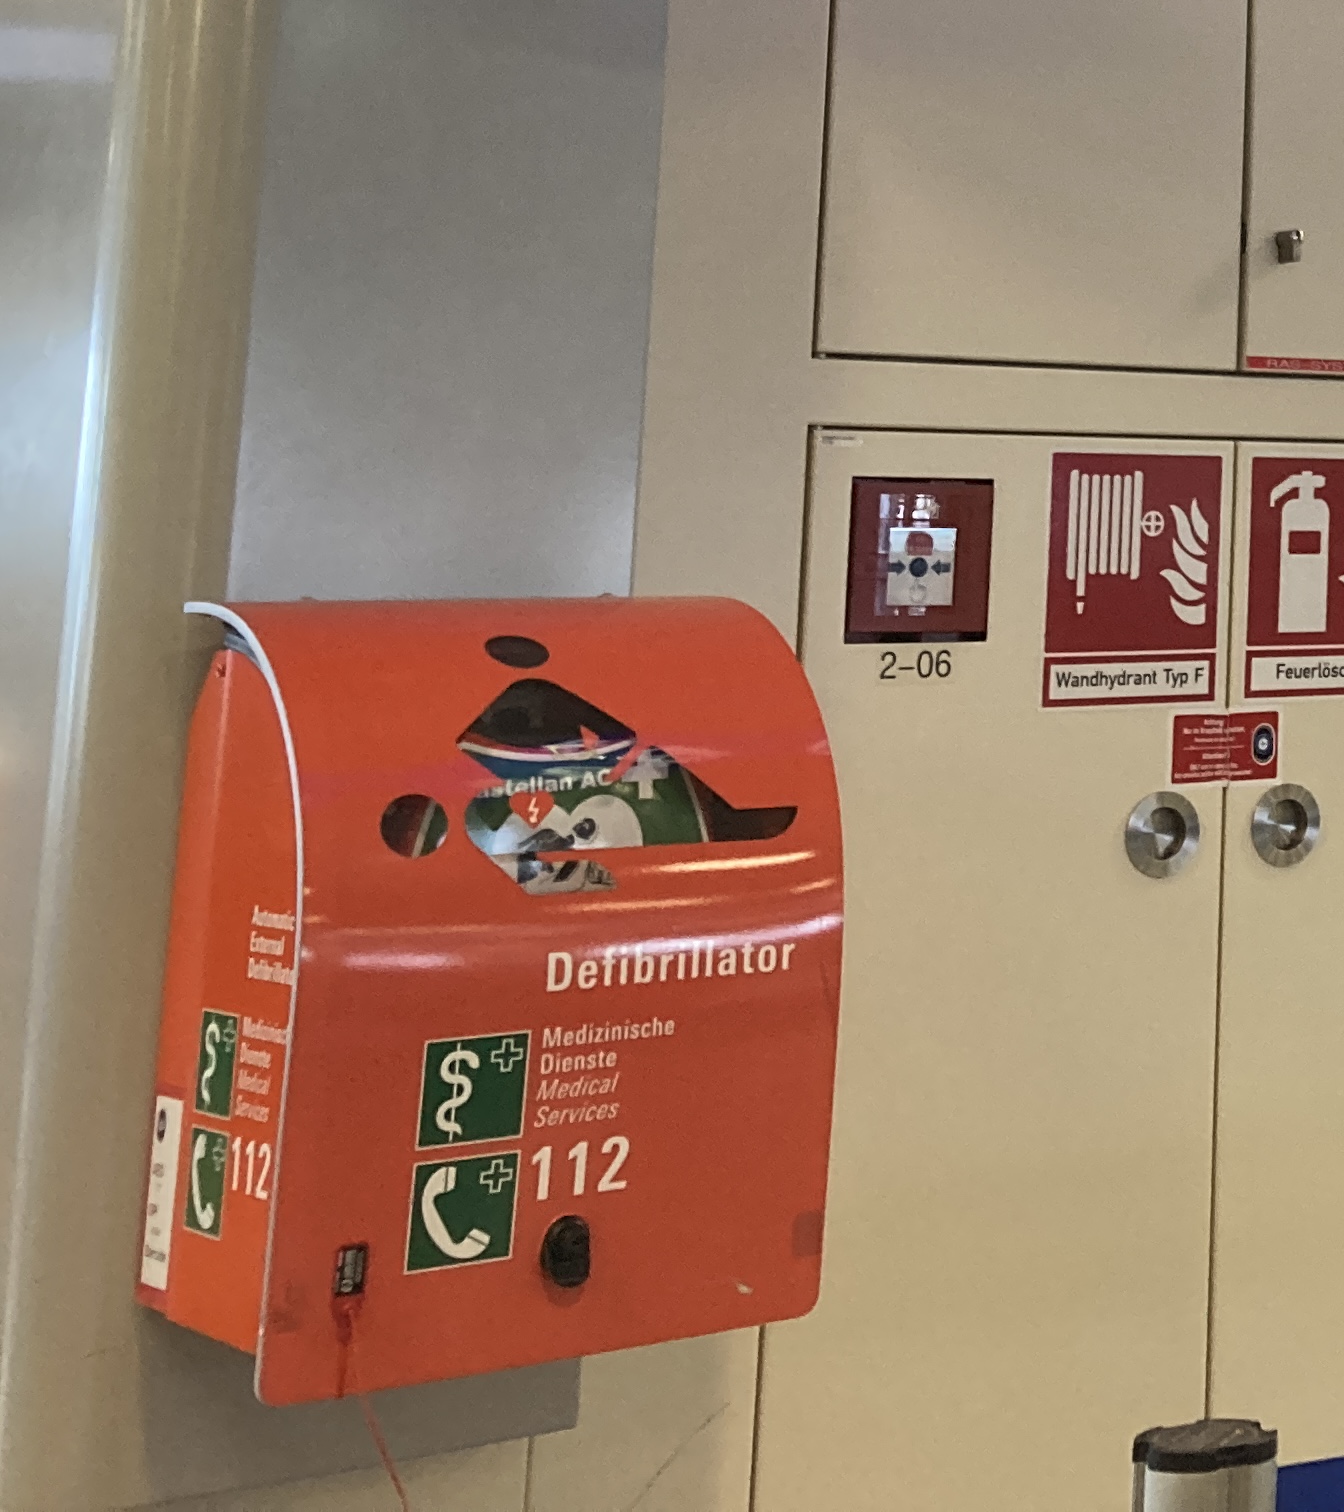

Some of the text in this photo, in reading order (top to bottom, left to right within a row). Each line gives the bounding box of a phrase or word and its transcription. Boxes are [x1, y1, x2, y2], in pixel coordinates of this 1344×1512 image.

[879, 649, 952, 679] 2-06
[1055, 667, 1205, 691] Wandhydrant Typ F
[545, 940, 796, 993] Defibrillator
[542, 1016, 676, 1049] Medizinische
[540, 1050, 618, 1076] Dienste
[536, 1071, 621, 1102] Medical
[533, 1101, 621, 1129] Services
[231, 1137, 272, 1202] 112
[531, 1136, 631, 1202] 112
